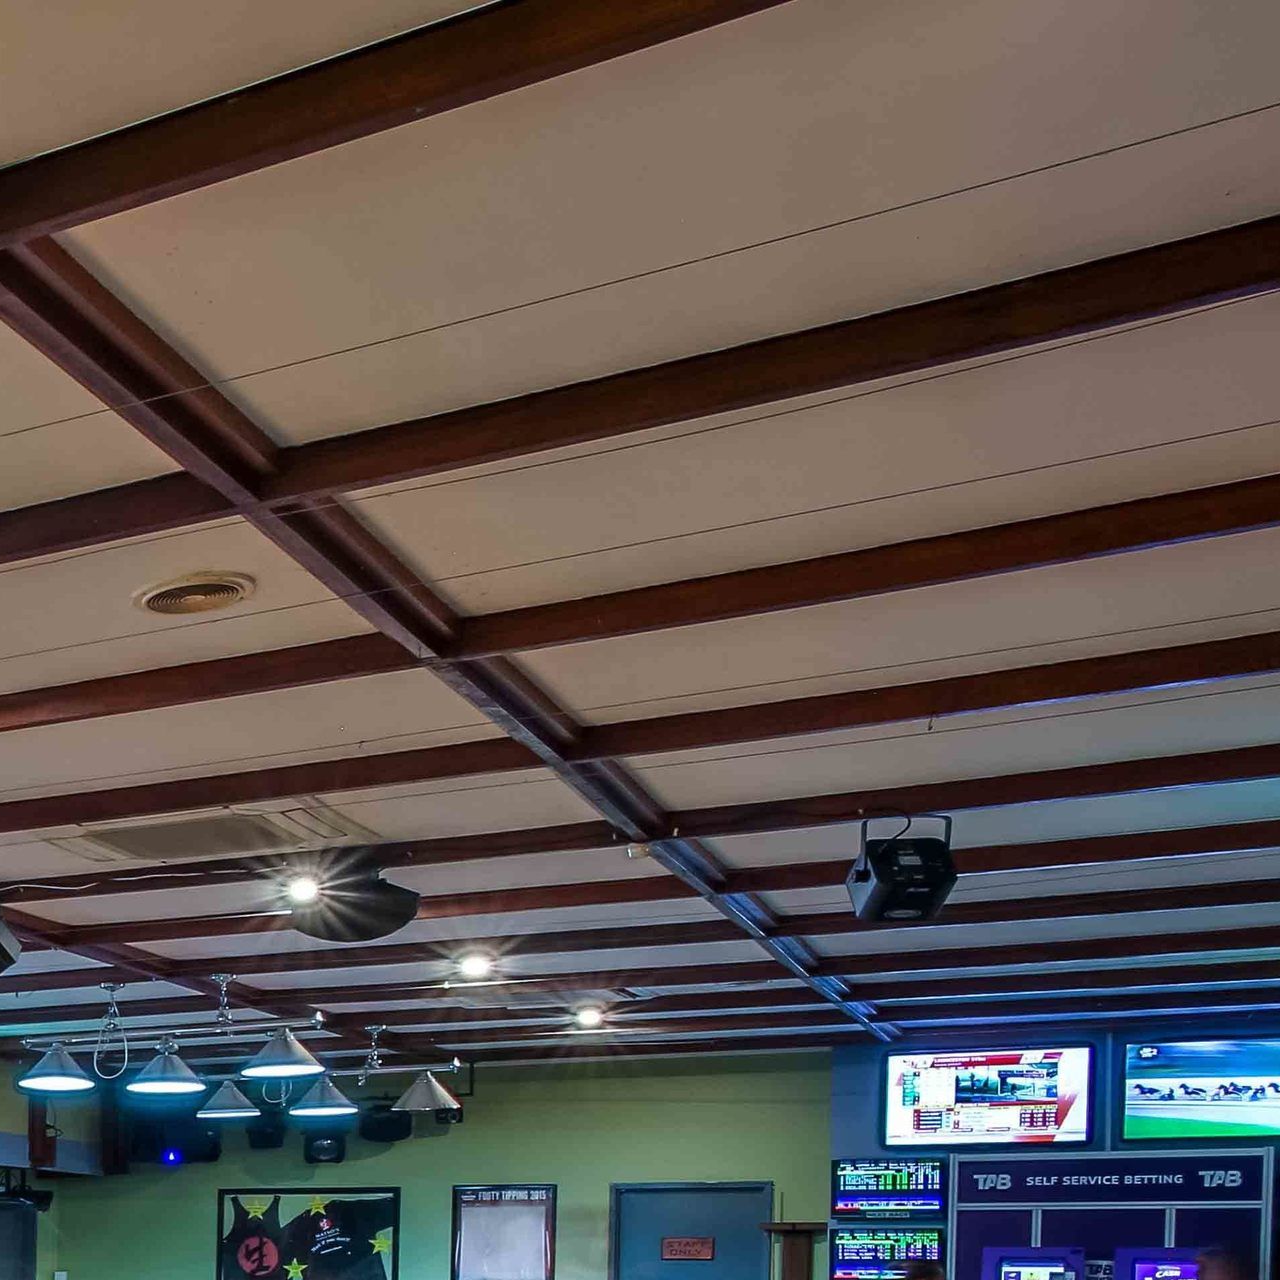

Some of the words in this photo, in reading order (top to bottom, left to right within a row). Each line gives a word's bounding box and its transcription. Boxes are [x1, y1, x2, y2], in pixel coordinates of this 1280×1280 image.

[973, 1174, 1011, 1190] TAB
[1026, 1176, 1058, 1186] SELF
[1062, 1175, 1120, 1186] SERVICE
[1124, 1174, 1184, 1185] BETTING
[1198, 1170, 1242, 1188] TAB
[478, 1191, 500, 1200] FOOTY
[502, 1191, 528, 1201] TIPPING
